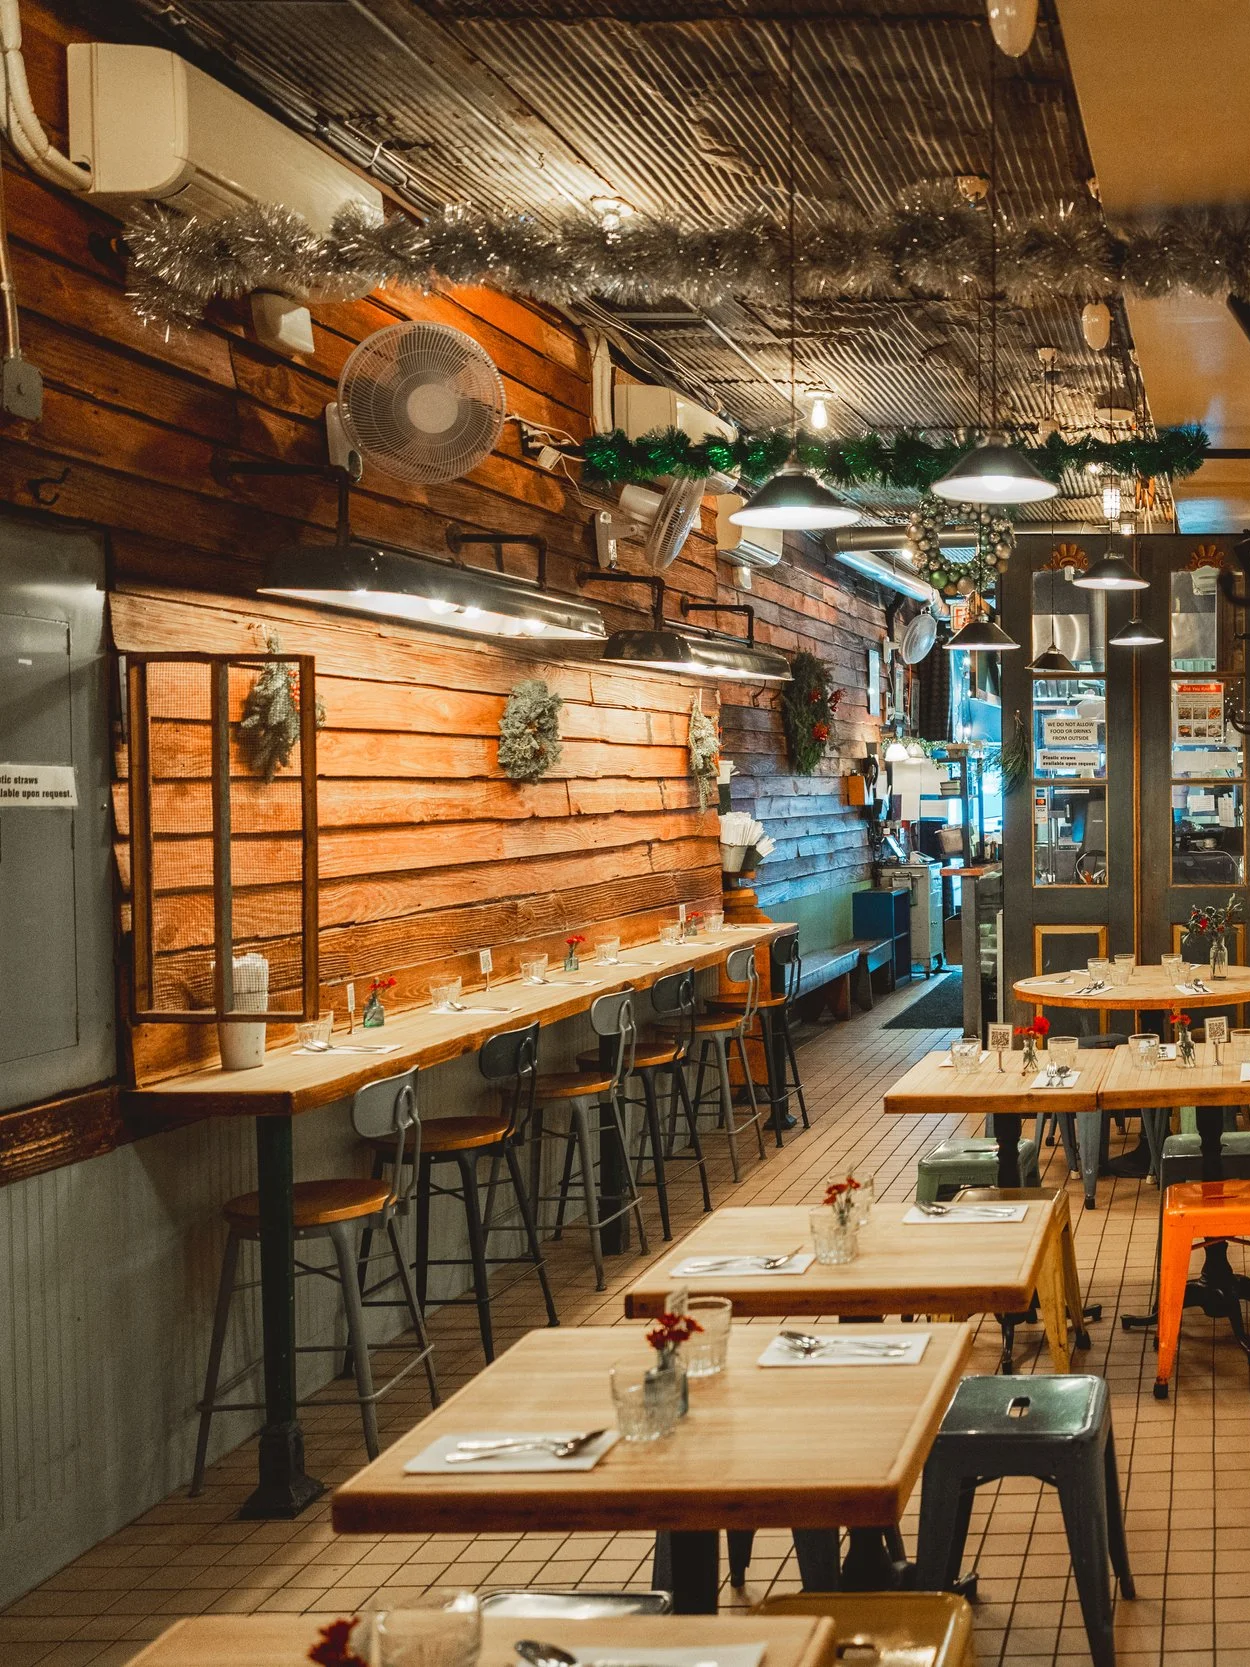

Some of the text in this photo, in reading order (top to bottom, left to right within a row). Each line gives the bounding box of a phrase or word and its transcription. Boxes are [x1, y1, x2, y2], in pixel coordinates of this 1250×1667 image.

[13, 776, 39, 785] straws
[22, 790, 40, 800] upon
[42, 789, 73, 800] request.
